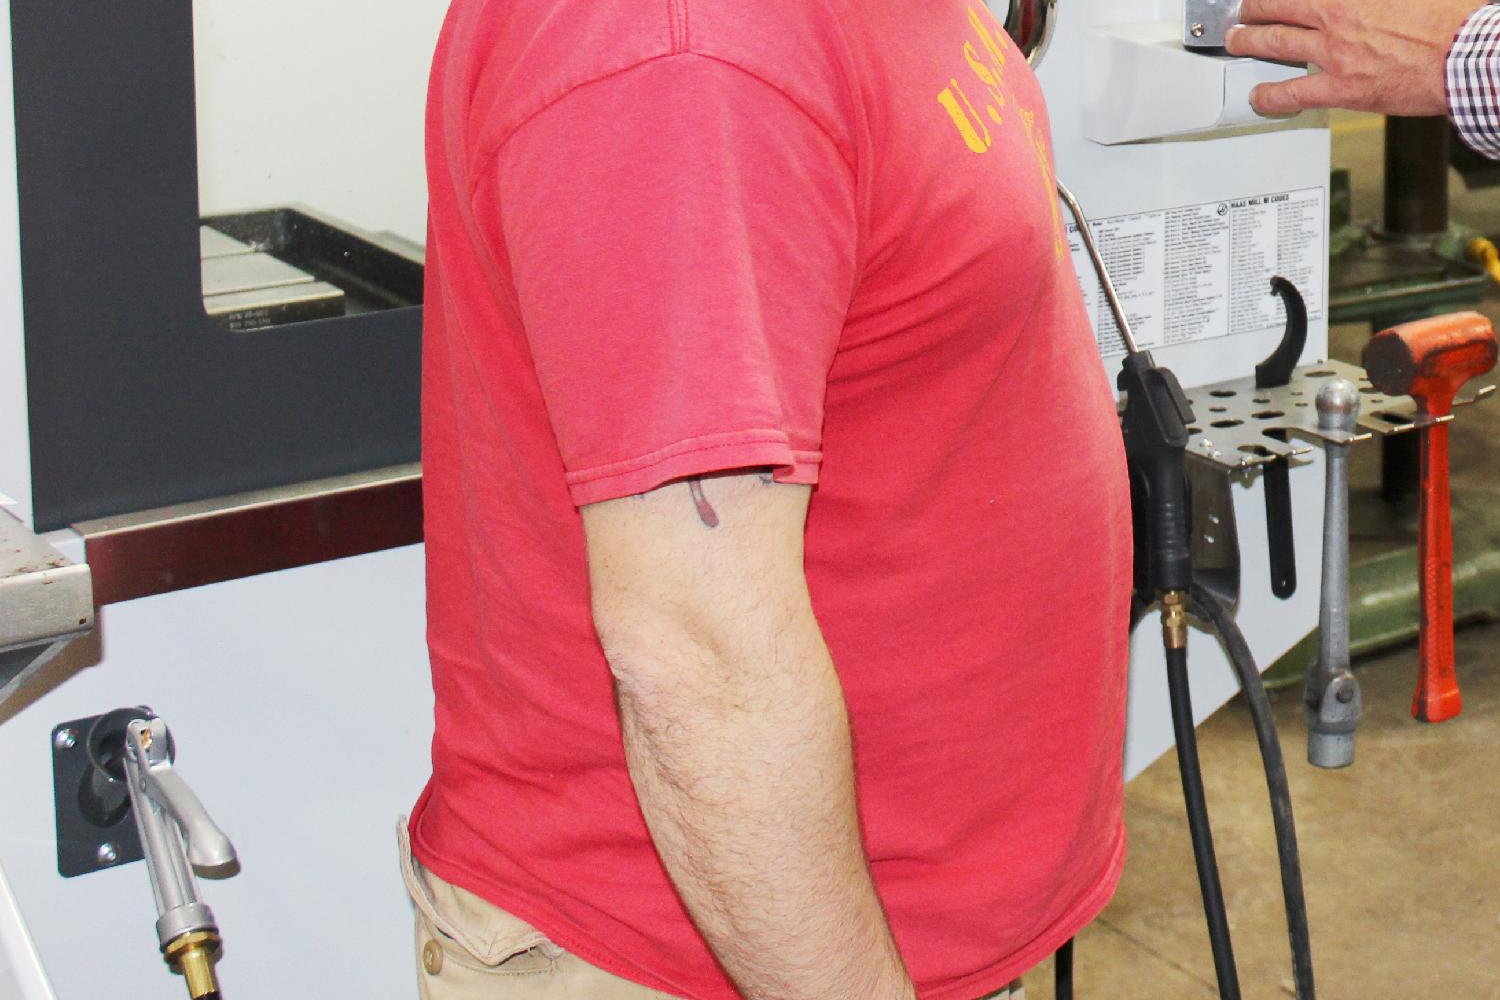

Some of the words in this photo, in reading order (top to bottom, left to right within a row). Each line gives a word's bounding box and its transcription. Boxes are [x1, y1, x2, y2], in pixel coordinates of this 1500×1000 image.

[1231, 199, 1247, 208] HAAS
[1248, 198, 1262, 206] MILL
[1271, 193, 1289, 204] CODES
